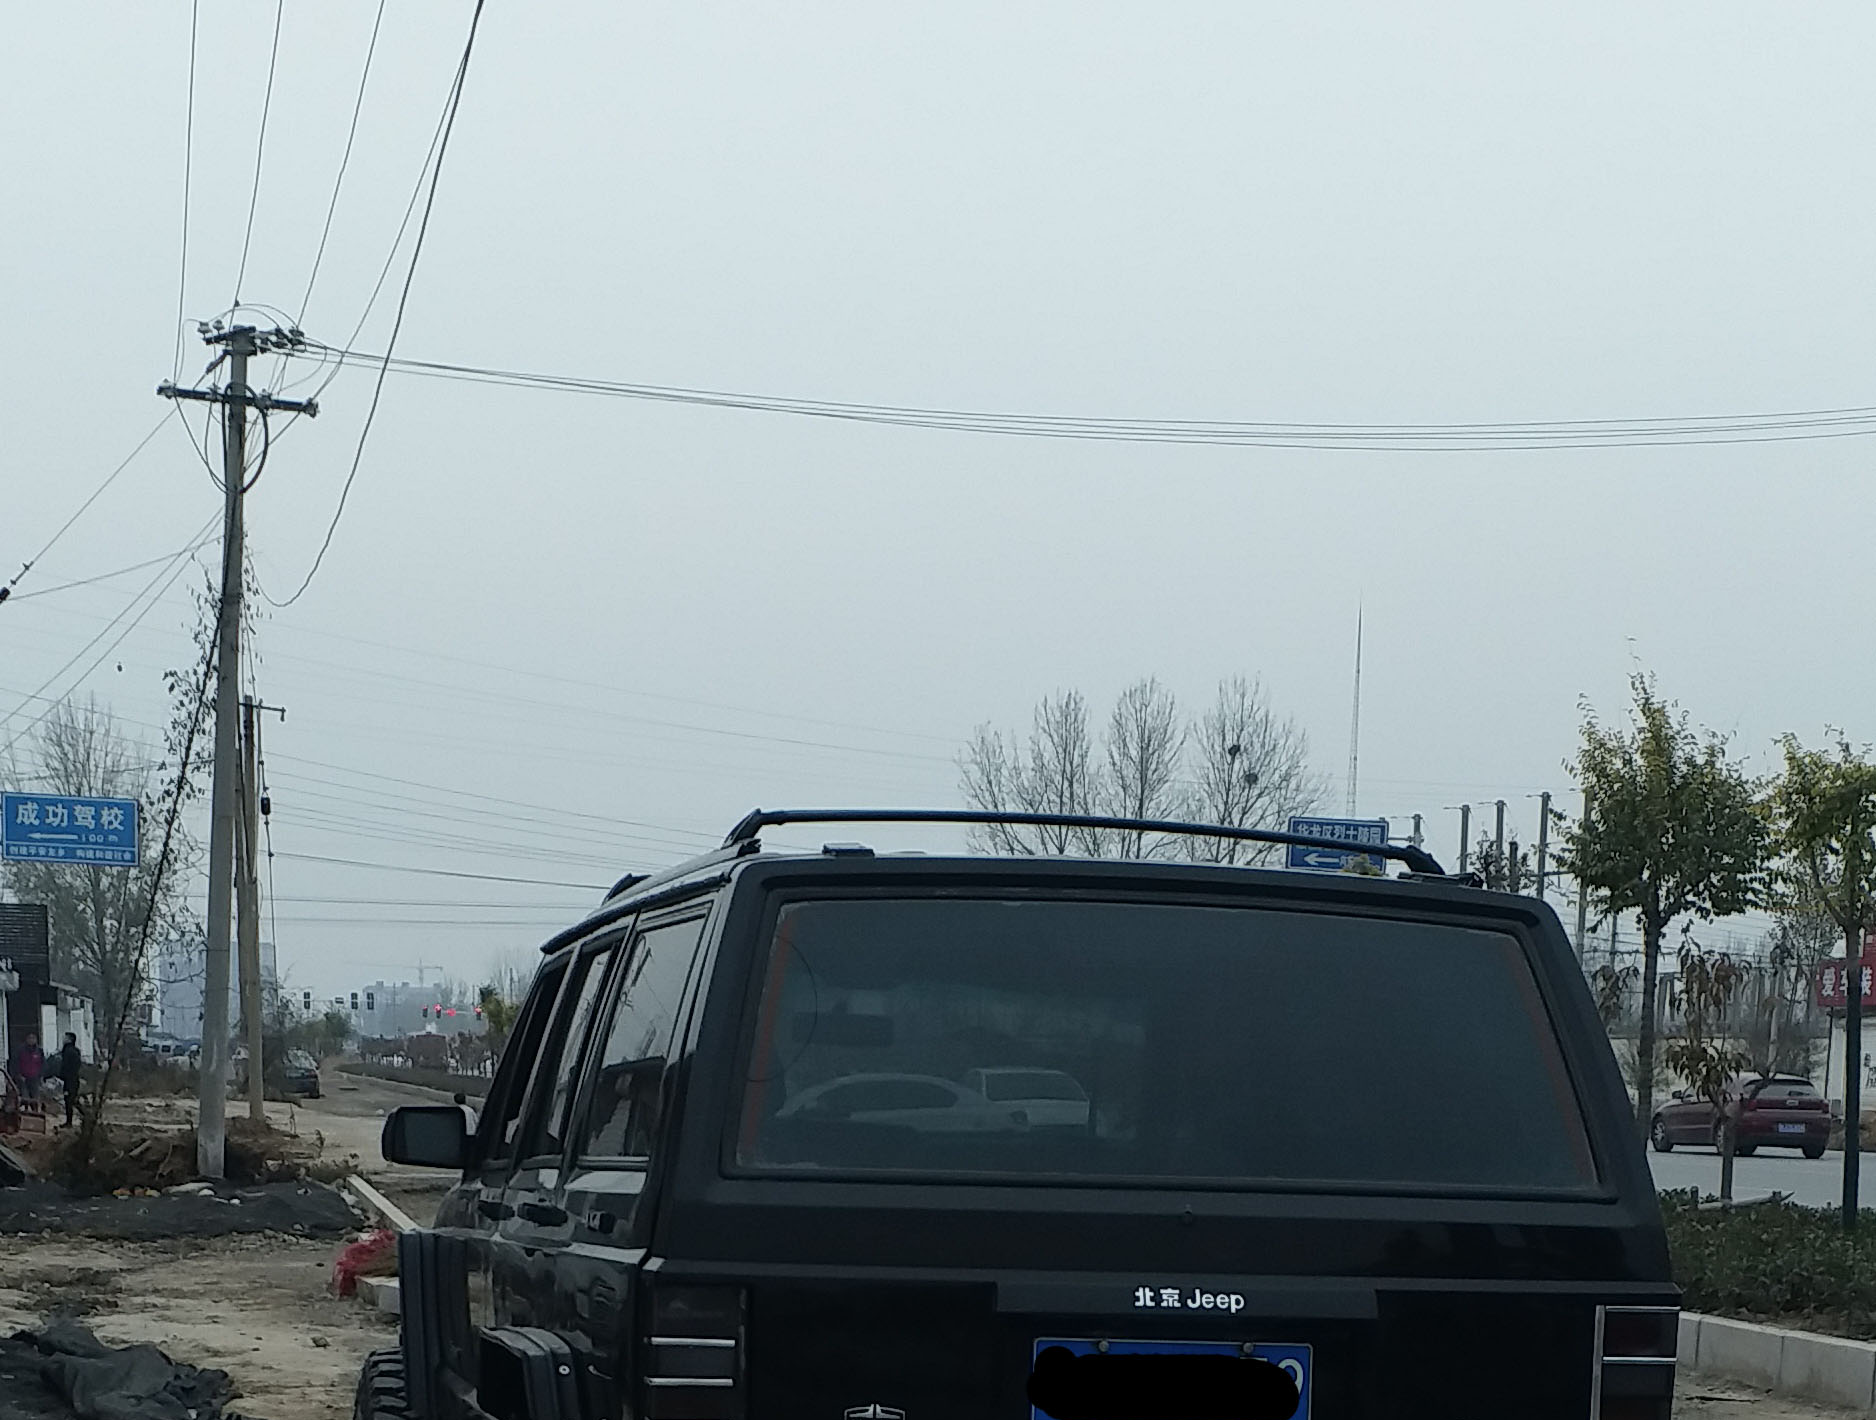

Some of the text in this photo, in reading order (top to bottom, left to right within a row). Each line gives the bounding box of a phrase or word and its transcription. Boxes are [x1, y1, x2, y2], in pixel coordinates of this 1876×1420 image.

[16, 801, 124, 830] 成功驾校
[81, 834, 104, 842] 100
[1134, 1287, 1245, 1313] 北京 Jeep
